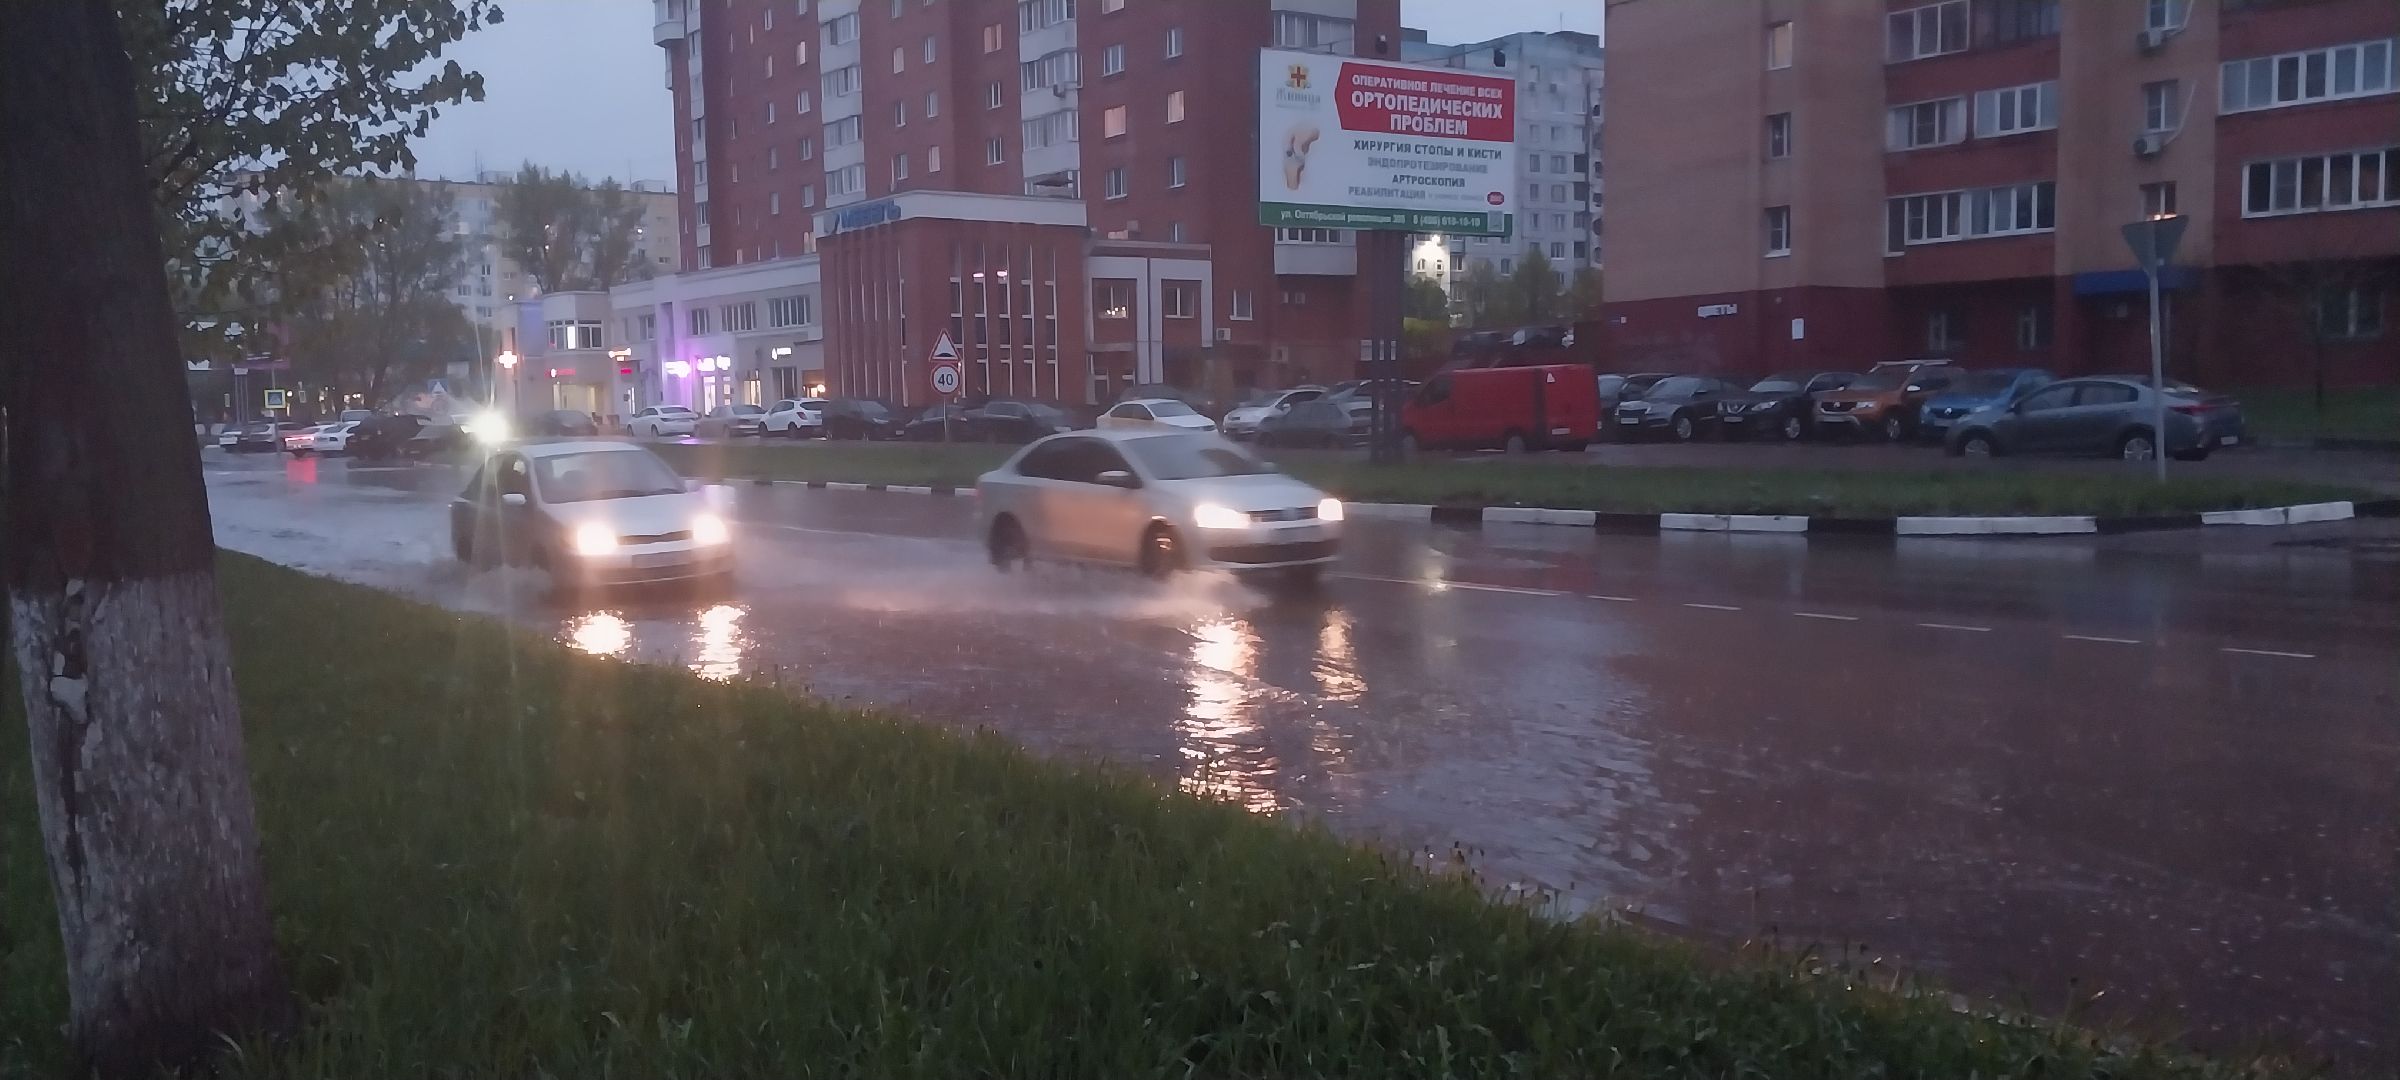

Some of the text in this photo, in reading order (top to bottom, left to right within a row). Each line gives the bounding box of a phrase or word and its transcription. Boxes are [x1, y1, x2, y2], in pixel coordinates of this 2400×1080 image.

[1352, 74, 1502, 99] ОПЕРАТИВНОЕ ЛЕЧЕНИЕ ВСЕХ
[1351, 90, 1502, 119] ОРТОПЕДИЧЕСКИХ
[1390, 113, 1468, 135] ПРОБЛЕМ
[1353, 139, 1502, 160] ХИРУРГИЯ СТОПЫ И КИСТИ
[1367, 156, 1488, 174] ЭНДОПРОТЕЗИРОВАНИЕ
[1392, 174, 1465, 188] АРТРОСКОПИЯ
[1348, 185, 1426, 200] РЕАБИЛИТАЦИЯ
[937, 373, 954, 386] 40
